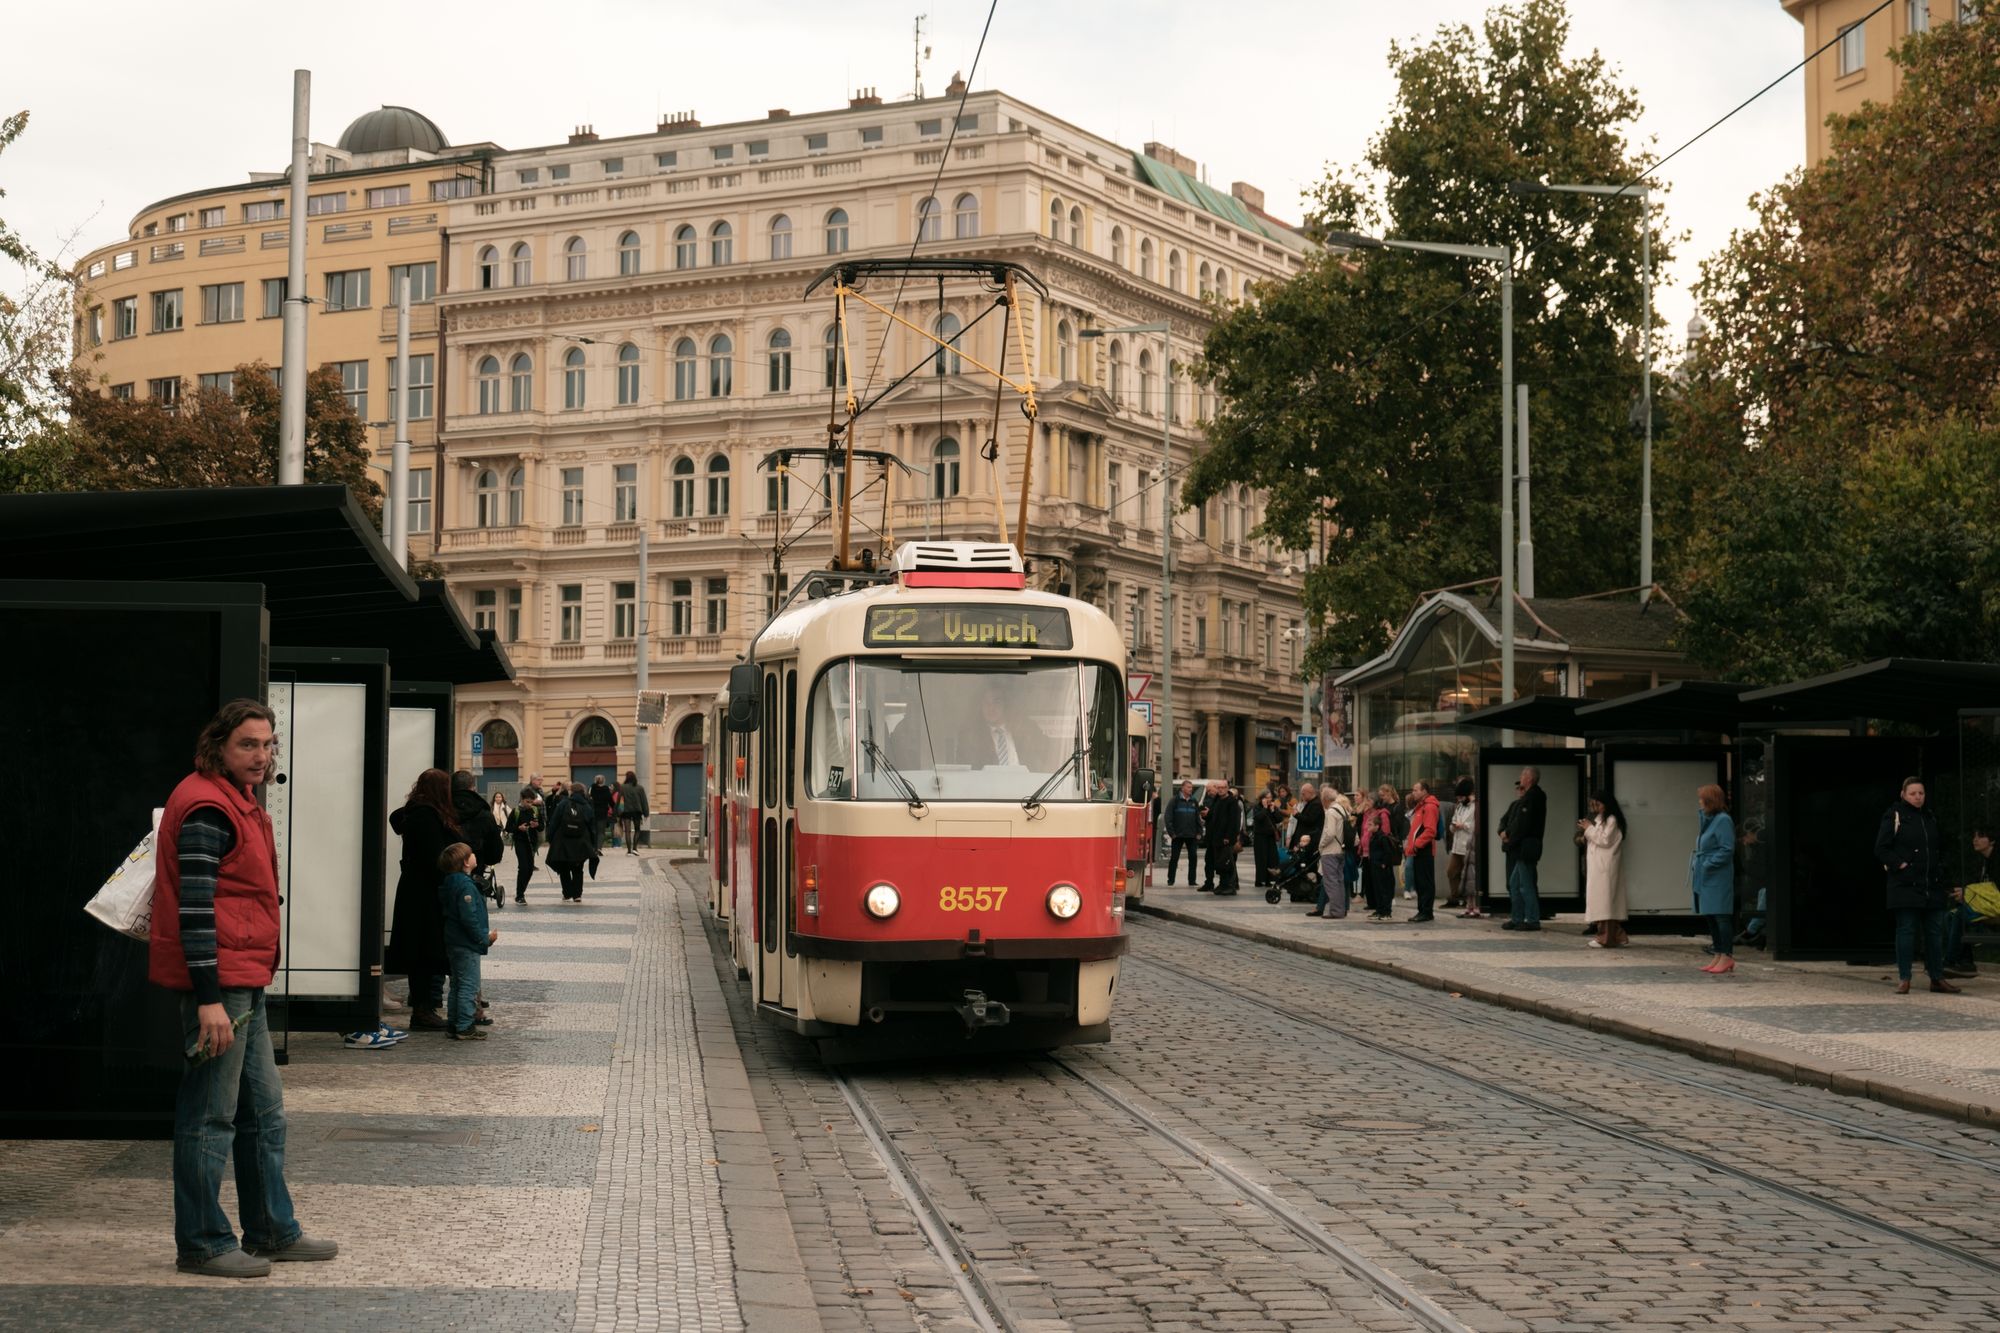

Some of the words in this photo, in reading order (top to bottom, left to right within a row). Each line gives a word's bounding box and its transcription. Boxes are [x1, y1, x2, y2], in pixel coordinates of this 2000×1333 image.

[871, 608, 919, 641] 22
[944, 612, 1038, 643] Vypich
[473, 735, 481, 748] P
[828, 770, 843, 788] 527
[939, 886, 1008, 912] 8557
